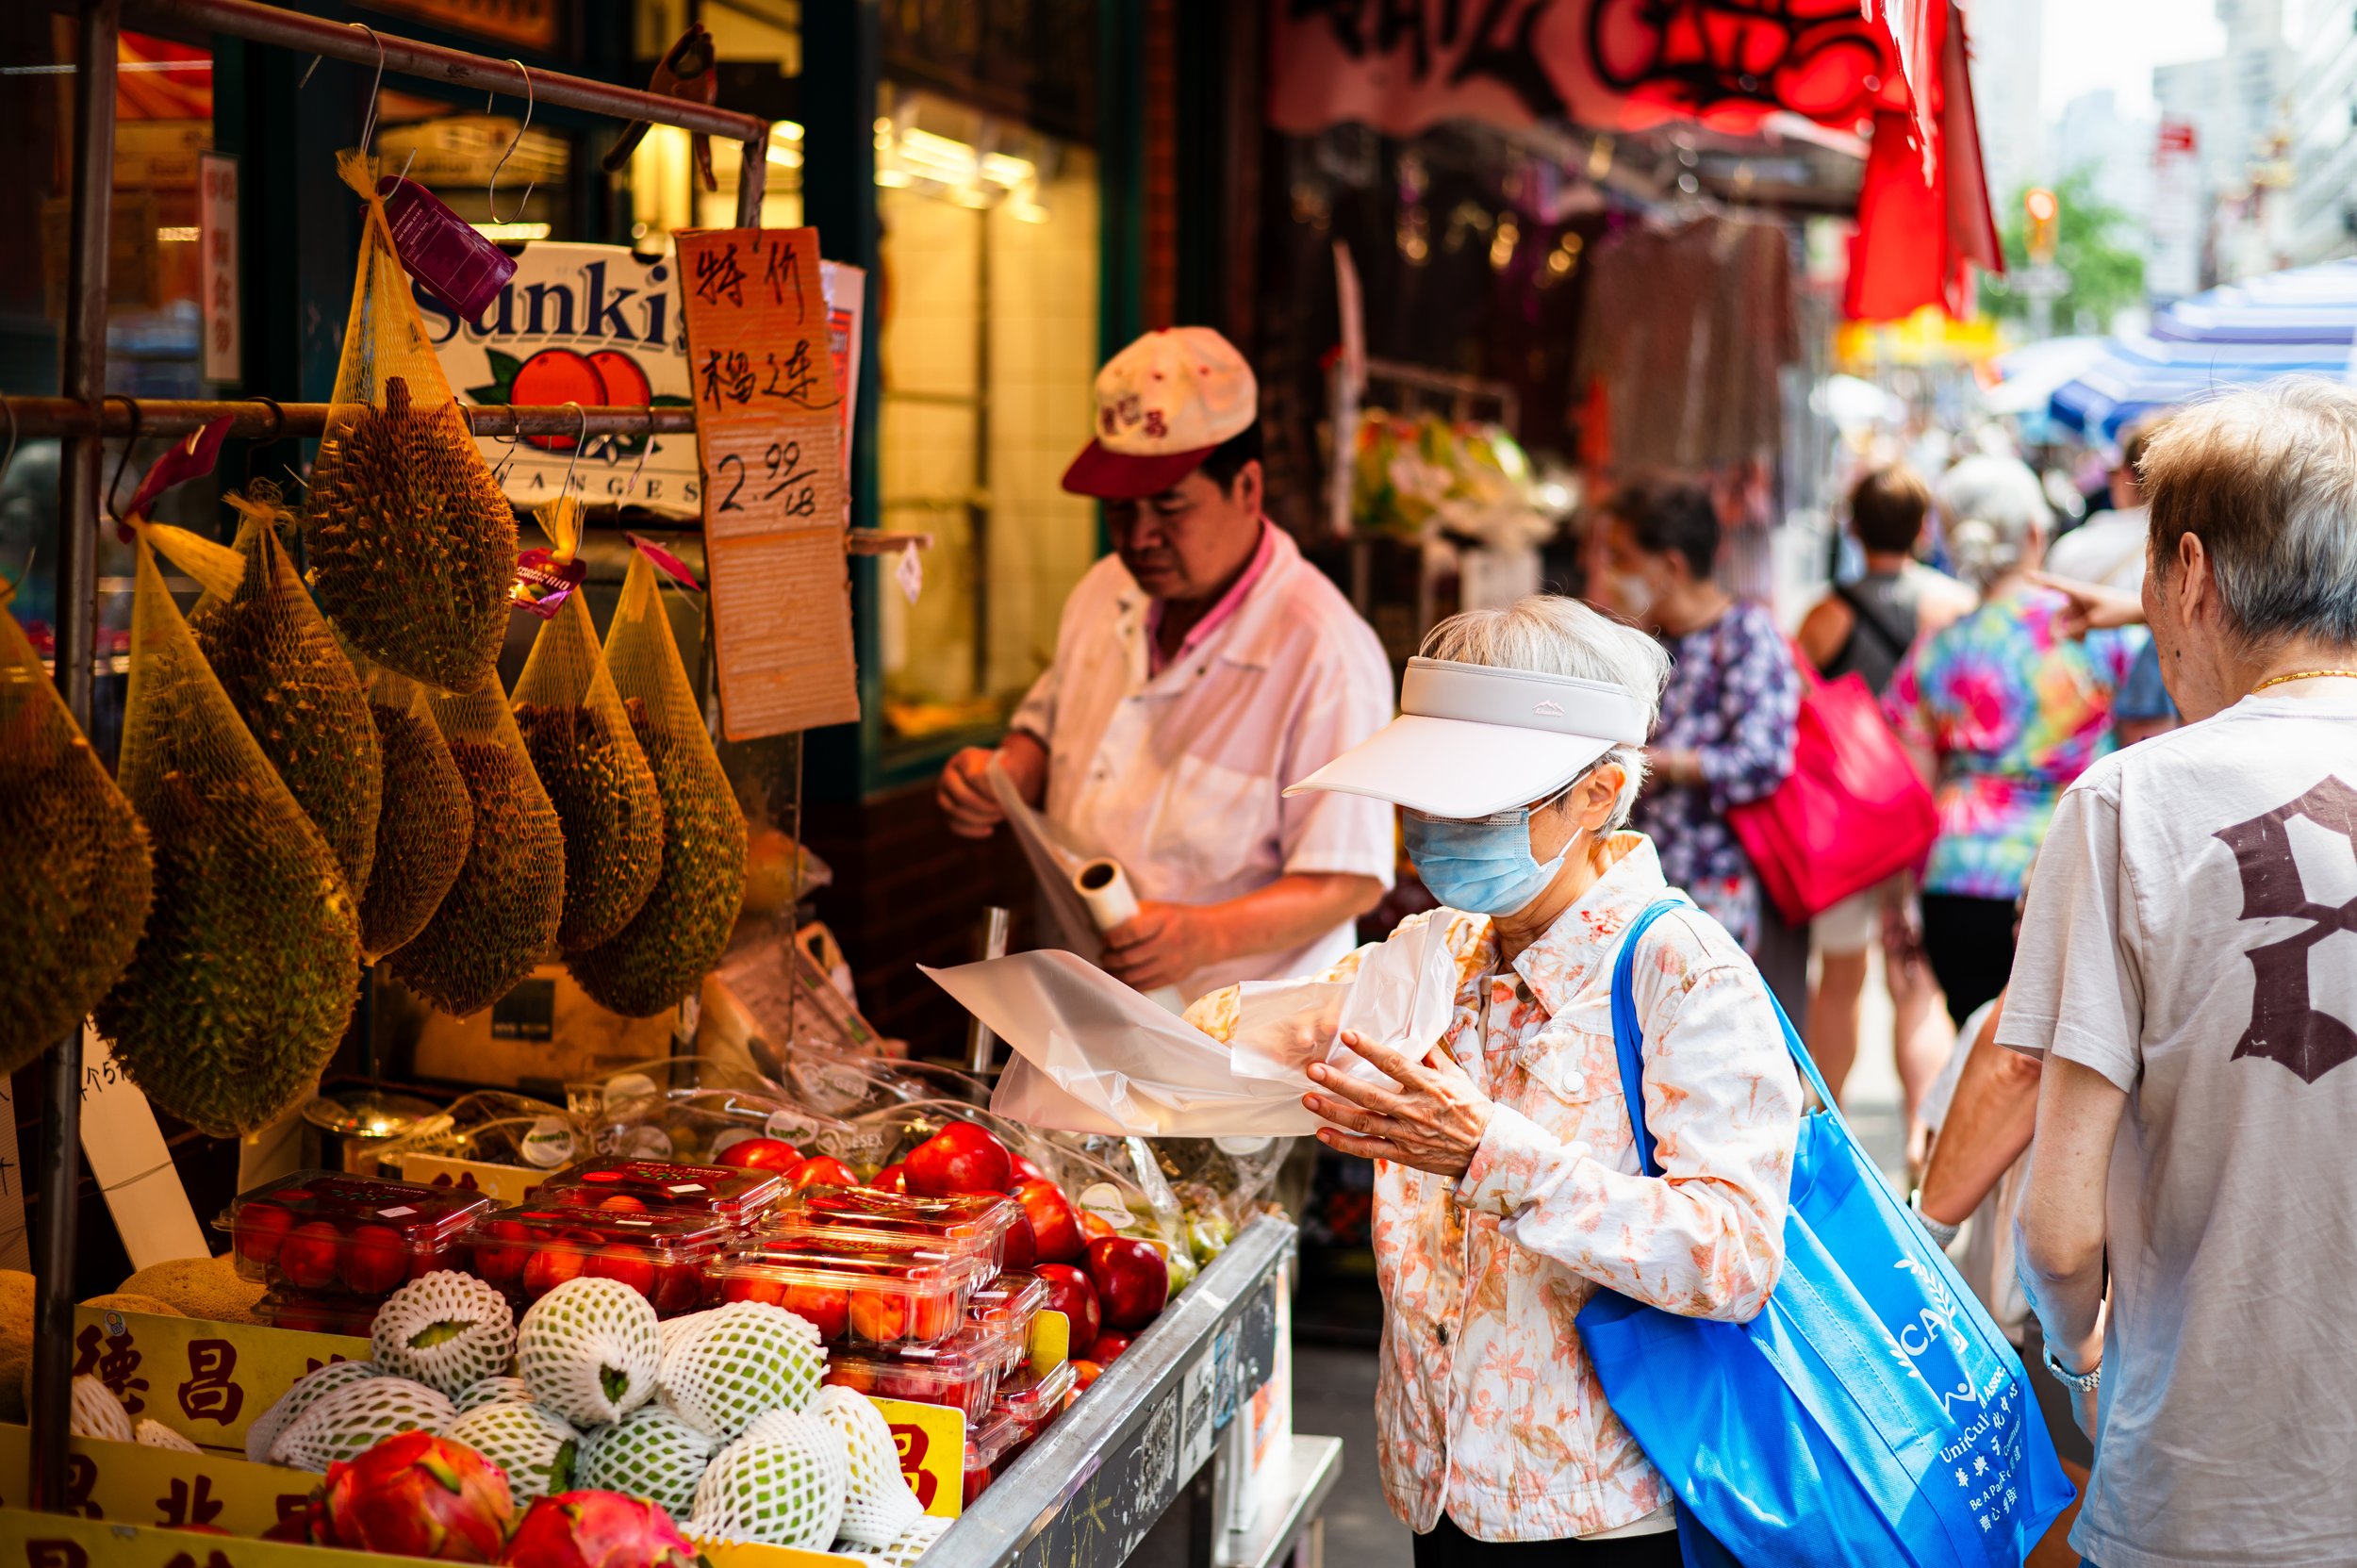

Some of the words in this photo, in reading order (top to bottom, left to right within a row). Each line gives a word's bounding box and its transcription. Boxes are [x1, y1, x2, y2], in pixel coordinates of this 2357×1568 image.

[411, 259, 688, 352] Sunki
[696, 240, 805, 326] 特价
[496, 470, 700, 503] ANGES
[1970, 1497, 1983, 1511] Be
[1983, 1491, 1990, 1502] A
